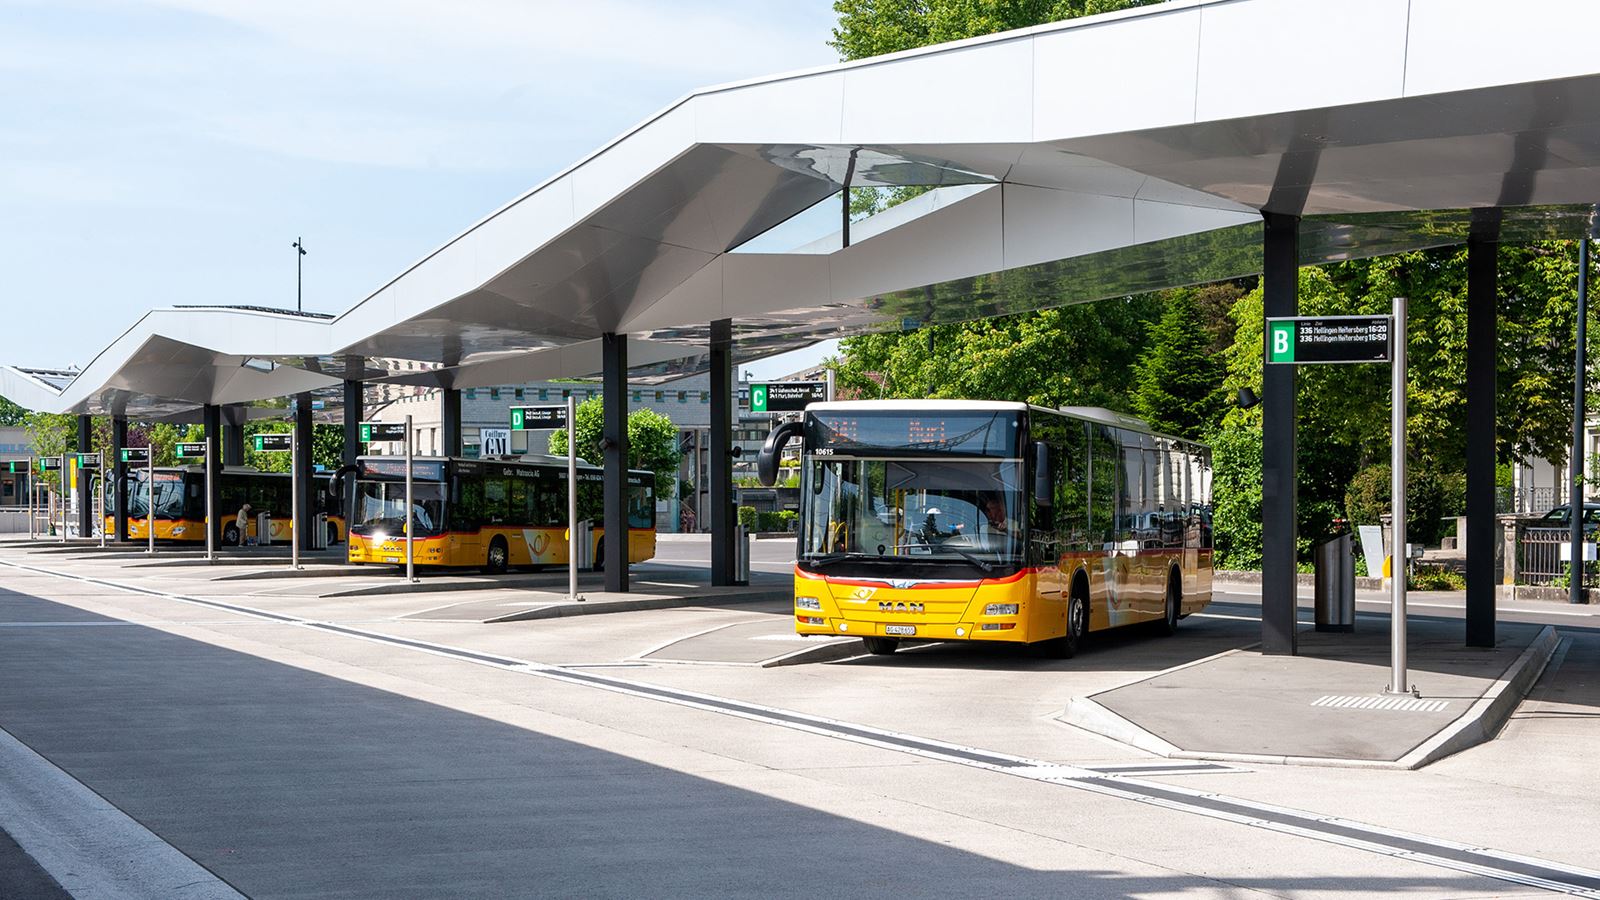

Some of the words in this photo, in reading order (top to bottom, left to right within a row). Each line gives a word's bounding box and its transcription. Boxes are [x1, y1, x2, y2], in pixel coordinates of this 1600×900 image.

[1299, 326, 1313, 335] 336
[1313, 326, 1338, 336] Mellingen
[1368, 325, 1387, 333] 16:20
[1273, 330, 1289, 354] B
[1299, 334, 1313, 343] 336
[1313, 334, 1338, 344] Mellingen
[1368, 333, 1387, 341] 16:50
[753, 389, 763, 407] C
[513, 412, 521, 426] D
[362, 427, 368, 438] E
[255, 439, 262, 448] F
[815, 448, 834, 456] 10615
[878, 601, 925, 612] MAN
